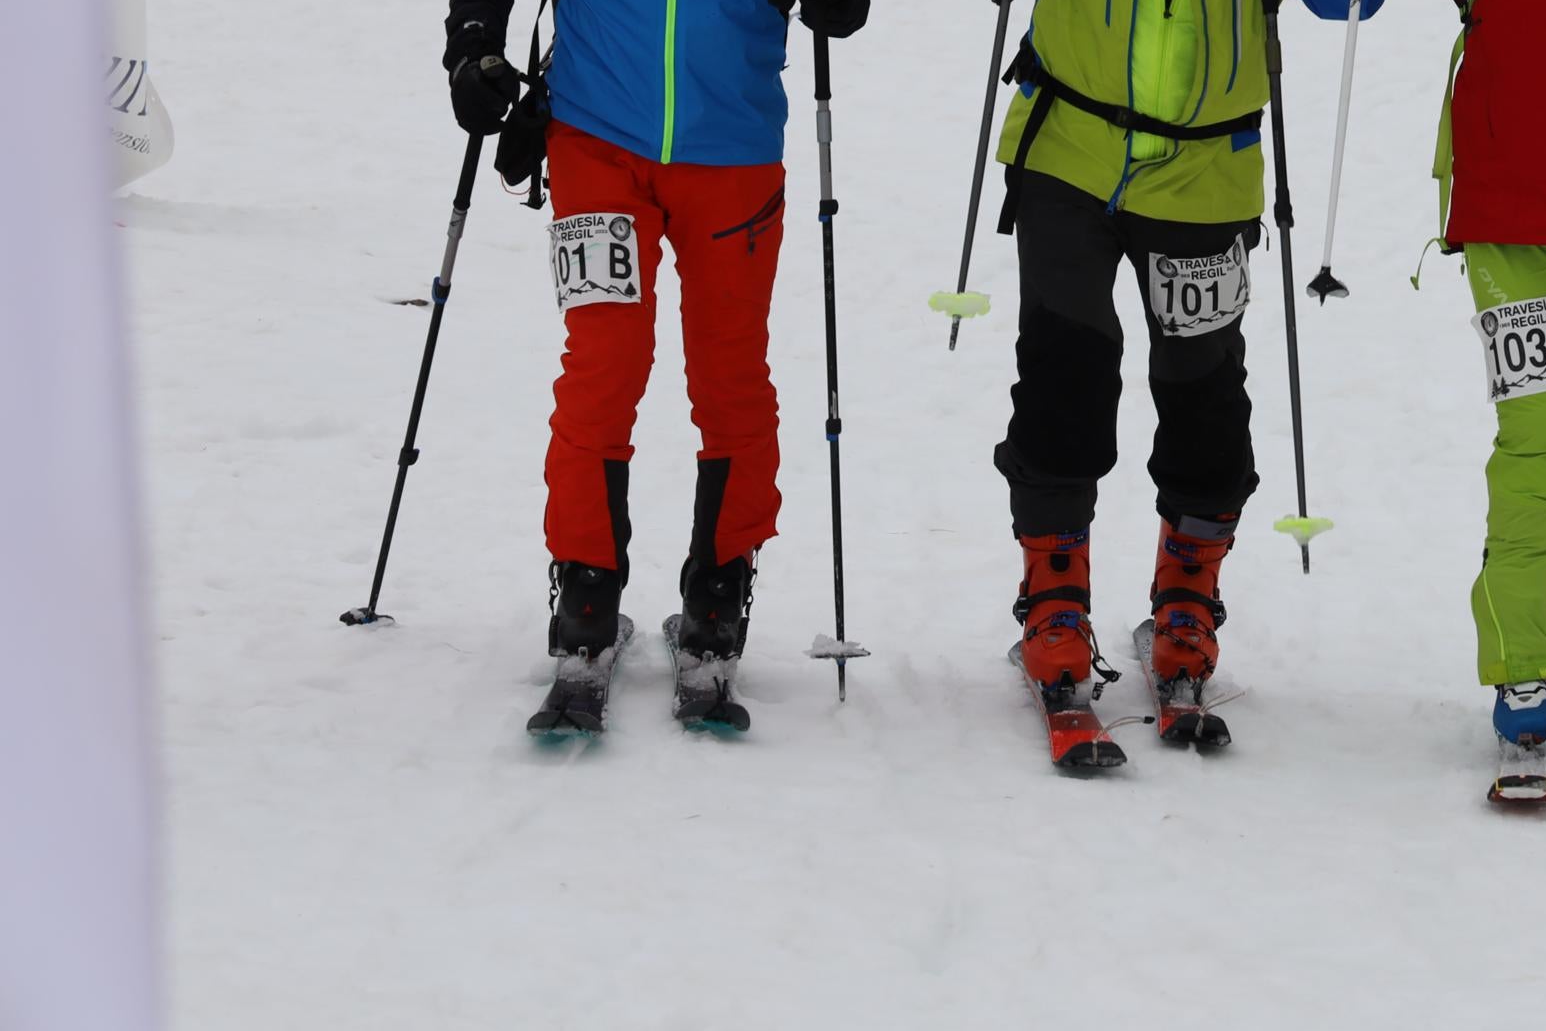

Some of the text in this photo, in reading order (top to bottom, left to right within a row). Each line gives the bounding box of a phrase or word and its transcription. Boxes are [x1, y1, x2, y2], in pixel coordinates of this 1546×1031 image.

[560, 228, 594, 242] REGIL
[609, 242, 633, 280] B
[1178, 255, 1232, 270] TRAVESA
[1191, 267, 1227, 280] REGIL
[1160, 279, 1219, 317] 101
